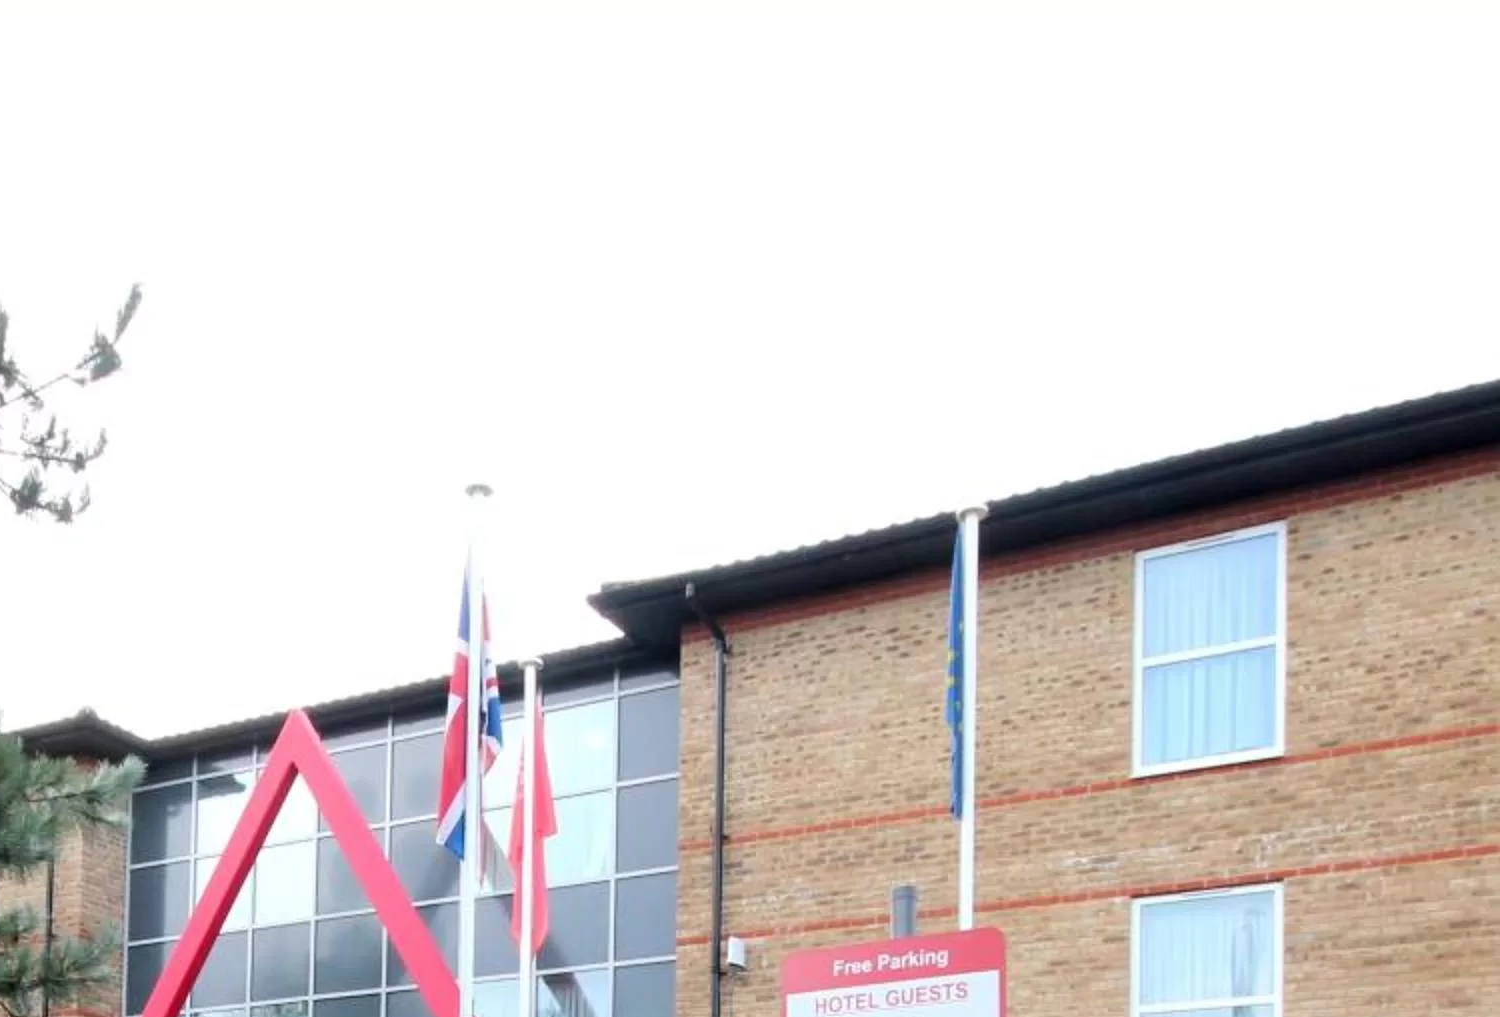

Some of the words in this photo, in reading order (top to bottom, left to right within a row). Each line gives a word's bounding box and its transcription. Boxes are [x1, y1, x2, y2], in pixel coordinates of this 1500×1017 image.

[832, 959, 873, 977] Free
[877, 949, 949, 971] Parking
[815, 992, 879, 1015] HOTEL
[885, 982, 969, 1007] GUESTS
